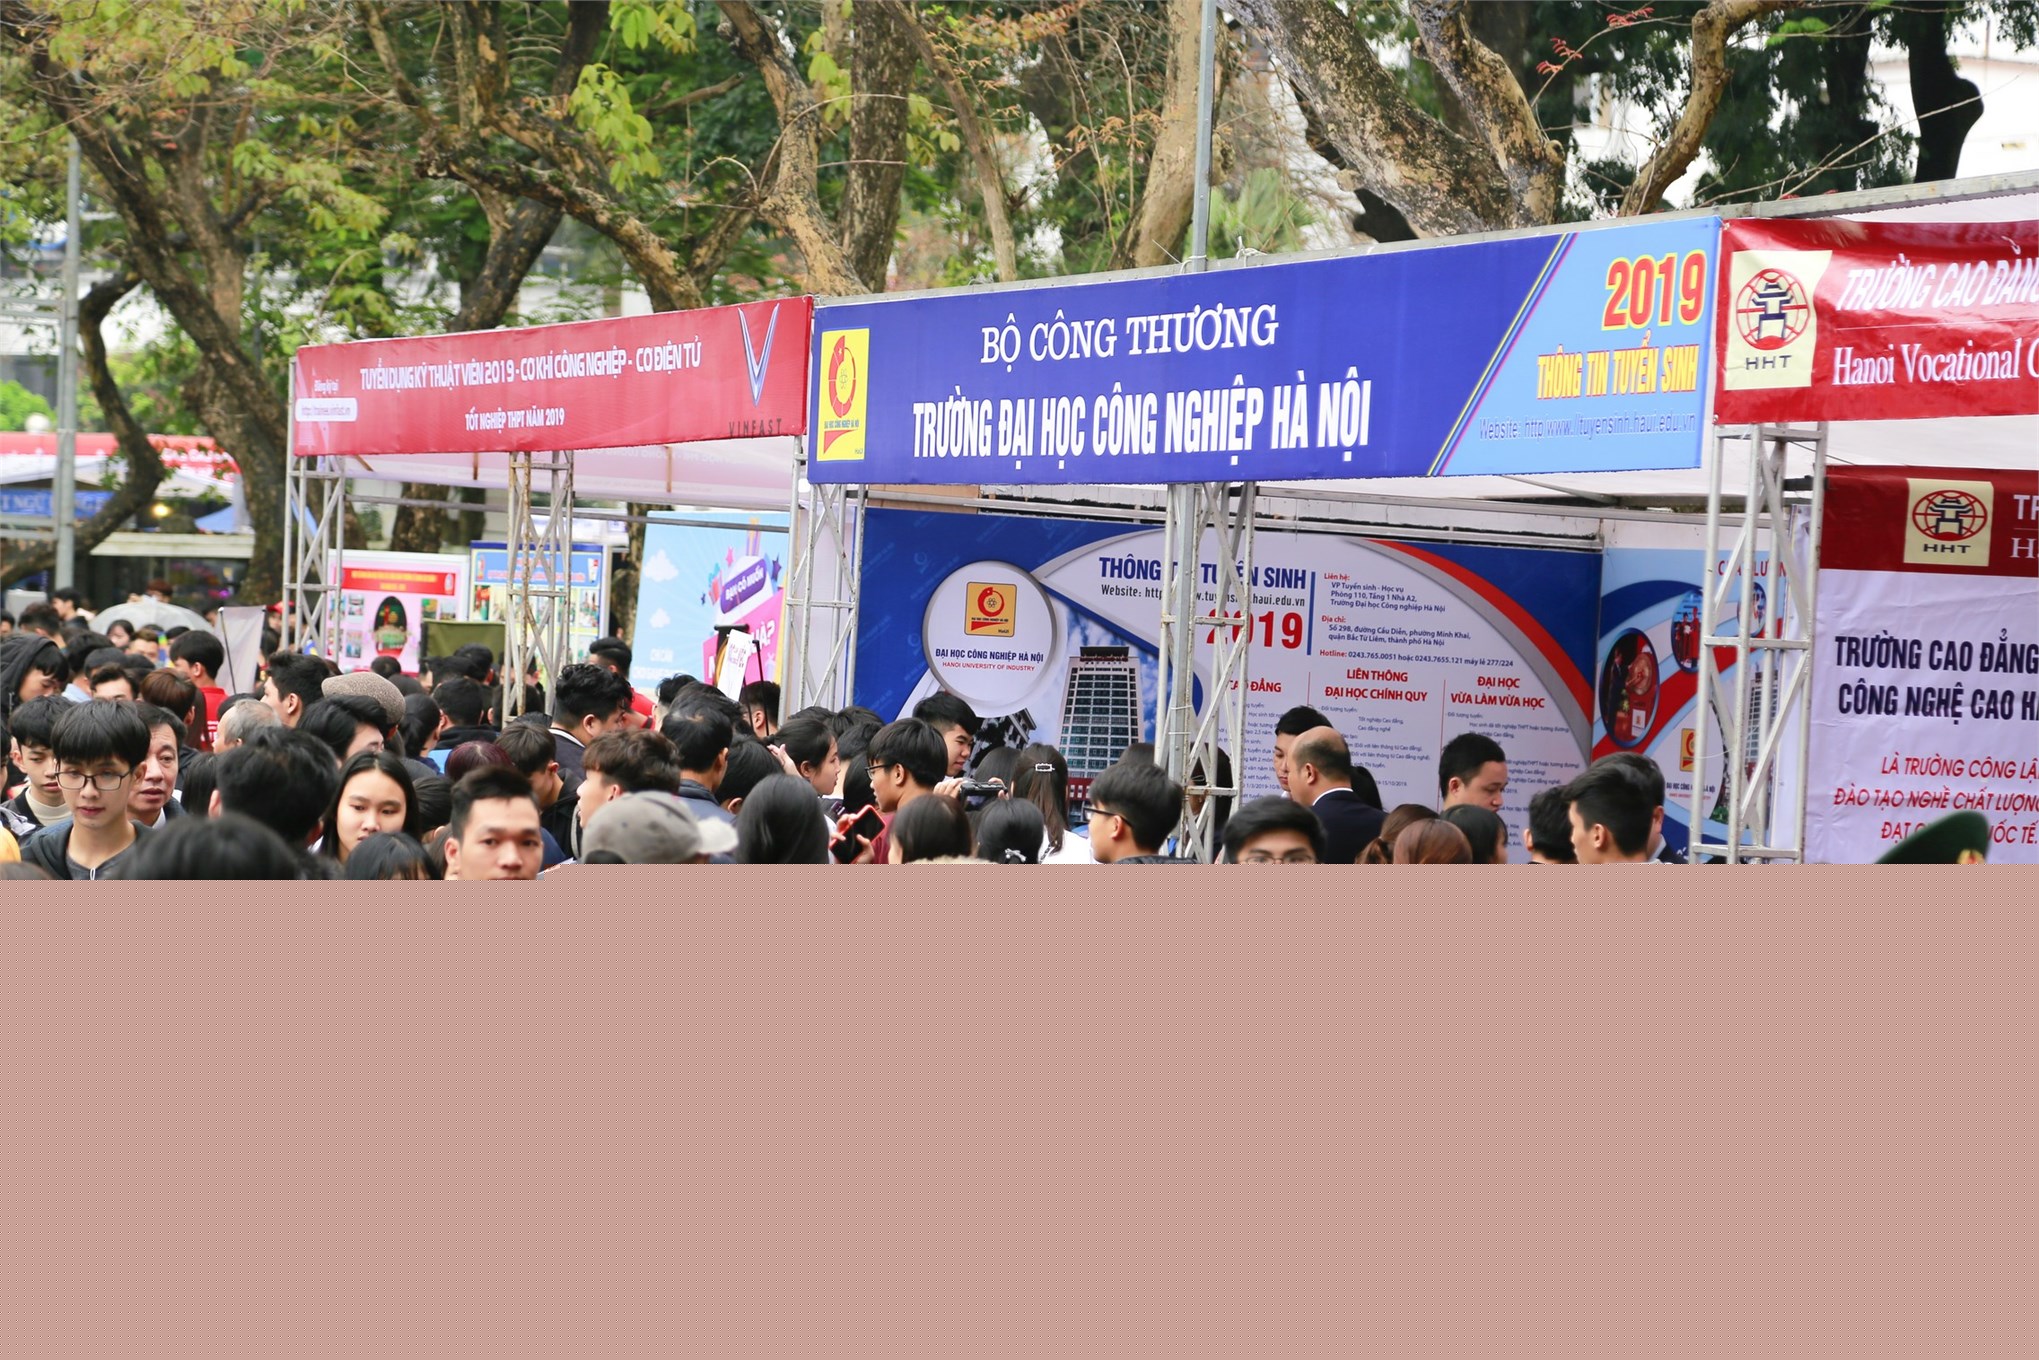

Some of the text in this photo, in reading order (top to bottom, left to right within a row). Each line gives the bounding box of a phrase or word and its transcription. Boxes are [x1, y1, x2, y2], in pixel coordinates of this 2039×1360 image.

[1602, 248, 1706, 331] 2019
[1836, 253, 1936, 311] TRƯỜNG
[1932, 260, 1989, 308] CAO
[981, 303, 1280, 372] BỘ CÔNG THƯƠNG
[389, 366, 414, 393] DỤNG
[428, 360, 460, 390] THUẬT
[462, 357, 484, 386] VIÊN
[485, 358, 514, 384] 2019
[537, 350, 554, 379] KHÍ
[554, 350, 585, 379] CÔNG
[585, 346, 627, 378] NGHIỆP
[654, 340, 682, 374] ĐIỆN
[1537, 328, 1699, 400] THÔNG TIN TUYỂN SINH
[1745, 355, 1792, 370] HHT
[1832, 344, 1894, 386] Hanoi
[1900, 338, 2021, 383] Vocational
[465, 405, 564, 434] TỐT NGHIỆP THPT NĂM 2019
[913, 366, 1372, 469] TRƯỜNG ĐẠI HỌC CÔNG NGHIỆP HÀ NỘI
[728, 418, 782, 438] VINFAST
[1479, 416, 1521, 440] Website:
[1923, 543, 1971, 553] HHT
[1099, 553, 1162, 581] THÔNG
[1263, 566, 1306, 589] SINH
[1324, 572, 1338, 580] Liên
[1101, 584, 1142, 597] Website:
[1331, 590, 1352, 599] Phòng
[1381, 585, 1394, 593] Học
[1331, 599, 1354, 608] Trường
[1355, 600, 1367, 608] Đại
[1368, 601, 1380, 610] học
[1381, 602, 1398, 610] Công
[1400, 603, 1422, 612] nghiệp
[1434, 605, 1445, 613] Nội
[1321, 615, 1332, 623] Địa
[1354, 626, 1376, 634] đường
[1409, 629, 1435, 638] phường
[1454, 632, 1471, 640] Khai,
[1409, 637, 1421, 645] phố
[1433, 638, 1444, 646] Nội
[935, 649, 1044, 664] ĐẠI HỌC CÔNG NGHIỆP HÀ NỘI
[1348, 651, 1396, 660] 0243.765.0051
[1398, 654, 1413, 662] hoặc
[1415, 655, 1462, 664] 0243.7655.121
[1464, 658, 1478, 666] máy
[1835, 628, 2039, 674] TRƯỜNG CAO ĐẲNG
[1250, 677, 1281, 692] ĐẲNG
[1347, 667, 1408, 683] LIÊN THÔNG
[1477, 676, 1520, 691] ĐẠI HỌC
[1324, 687, 1427, 702] ĐẠI HỌC CHÍNH QUY
[1451, 691, 1545, 710] VỪA LÀM VỪA HỌC
[1838, 678, 1898, 716] CÔNG
[1905, 681, 1964, 725] NGHỆ
[1971, 689, 2015, 720] CAO
[1881, 751, 1899, 775] LÀ
[1904, 753, 1964, 777] TRƯỜNG
[1968, 756, 2016, 779] CÔNG
[1833, 782, 1870, 806] ĐÀO
[1873, 789, 1904, 811] TẠO
[1907, 785, 1951, 809] NGHỀ
[1952, 786, 1994, 810] CHẤT
[1881, 821, 1911, 843] ĐẠT
[2021, 820, 2038, 845] TẾ.
